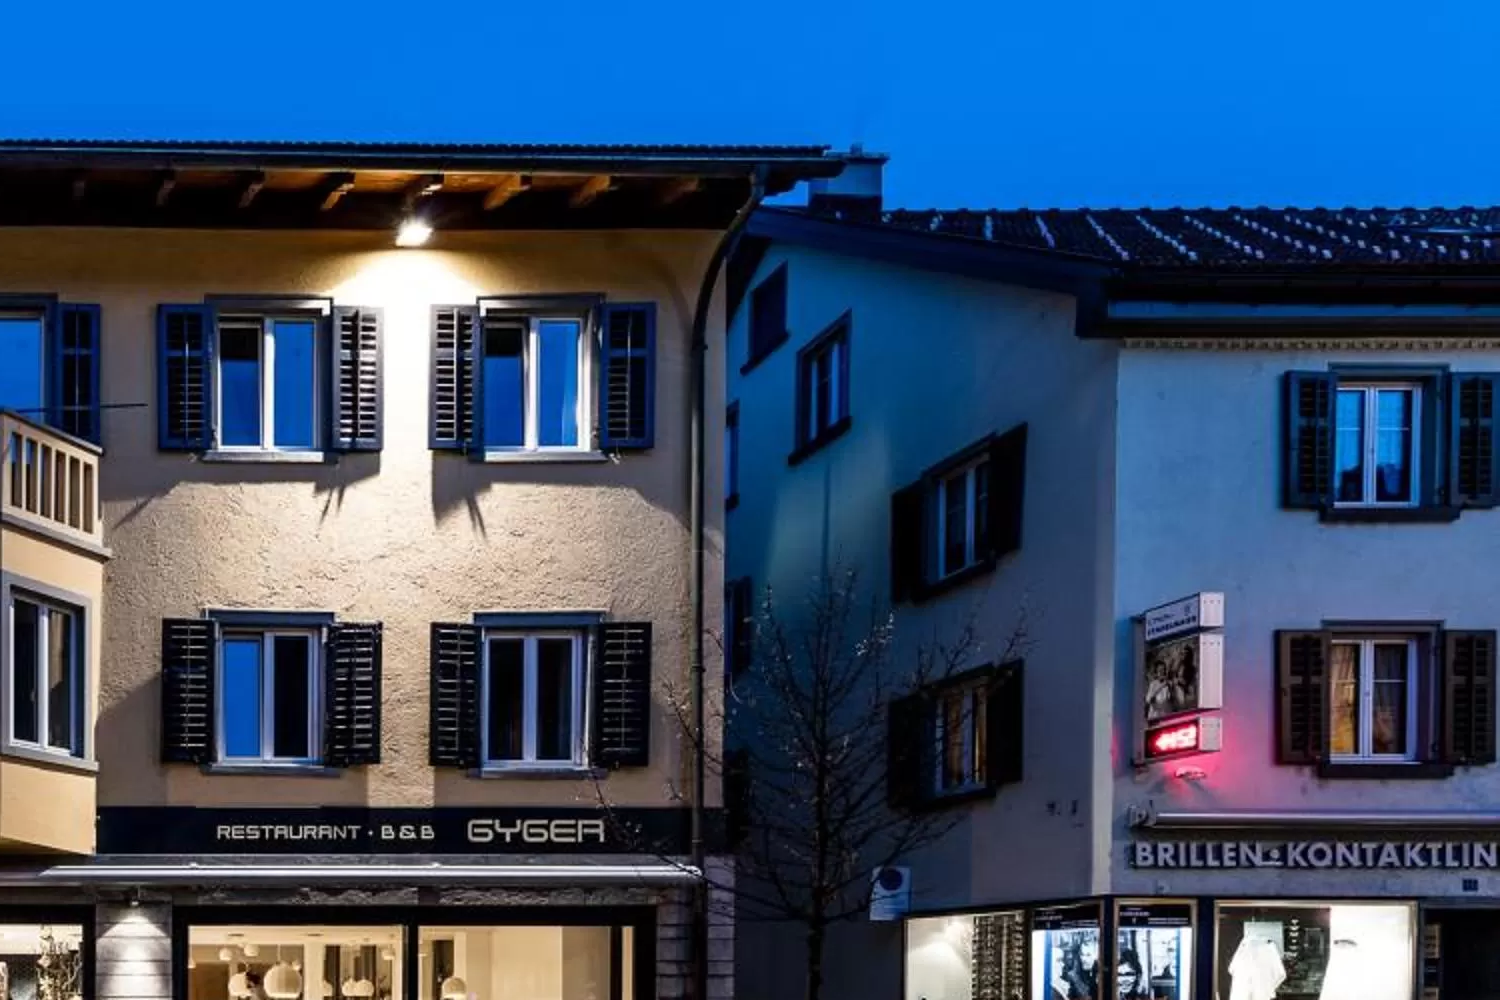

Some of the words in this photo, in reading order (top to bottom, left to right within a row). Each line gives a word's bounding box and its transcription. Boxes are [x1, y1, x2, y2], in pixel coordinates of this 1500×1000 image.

[216, 824, 361, 840] RESTAURANT
[467, 819, 605, 843] GYGER
[1134, 841, 1262, 868] BRILLEN
